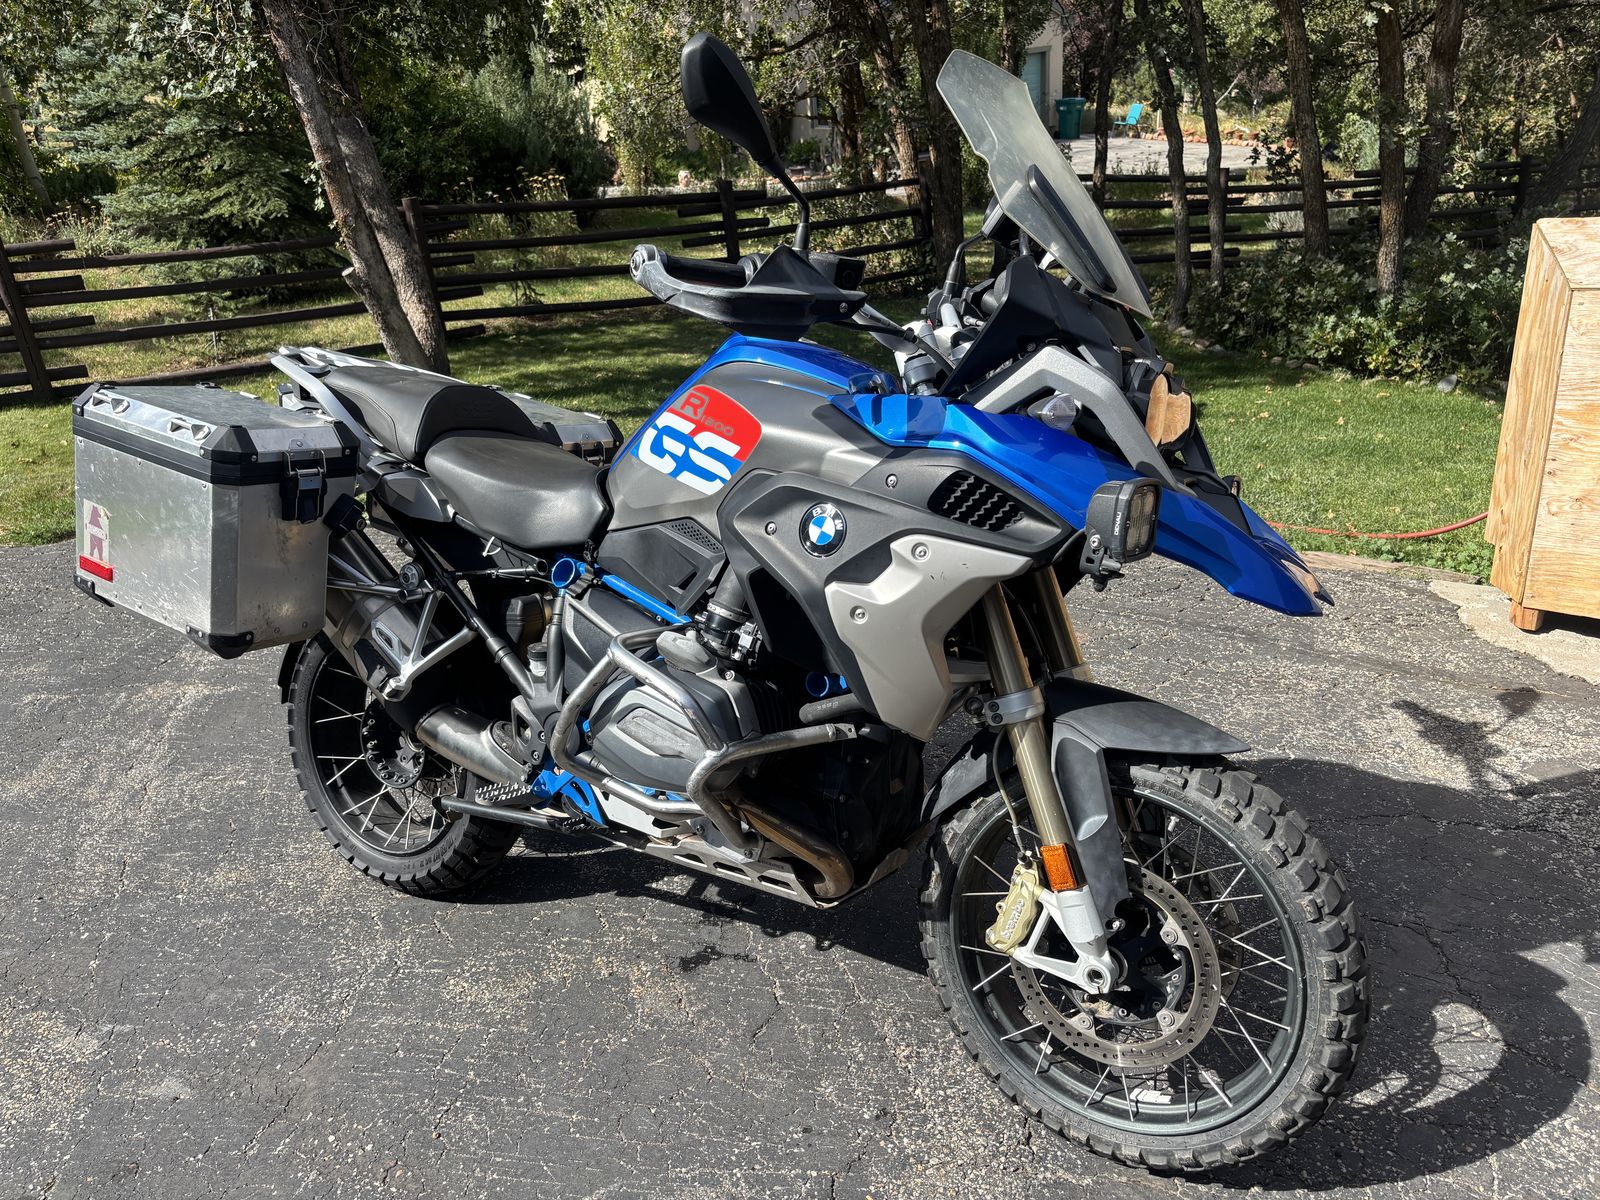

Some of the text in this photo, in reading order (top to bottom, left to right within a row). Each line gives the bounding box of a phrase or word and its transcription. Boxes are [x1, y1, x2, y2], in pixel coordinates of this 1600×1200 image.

[678, 390, 735, 436] R 1200
[638, 411, 741, 495] GS
[812, 504, 844, 530] BMW
[1113, 511, 1122, 536] DENALI
[1001, 898, 1026, 940] brembo
